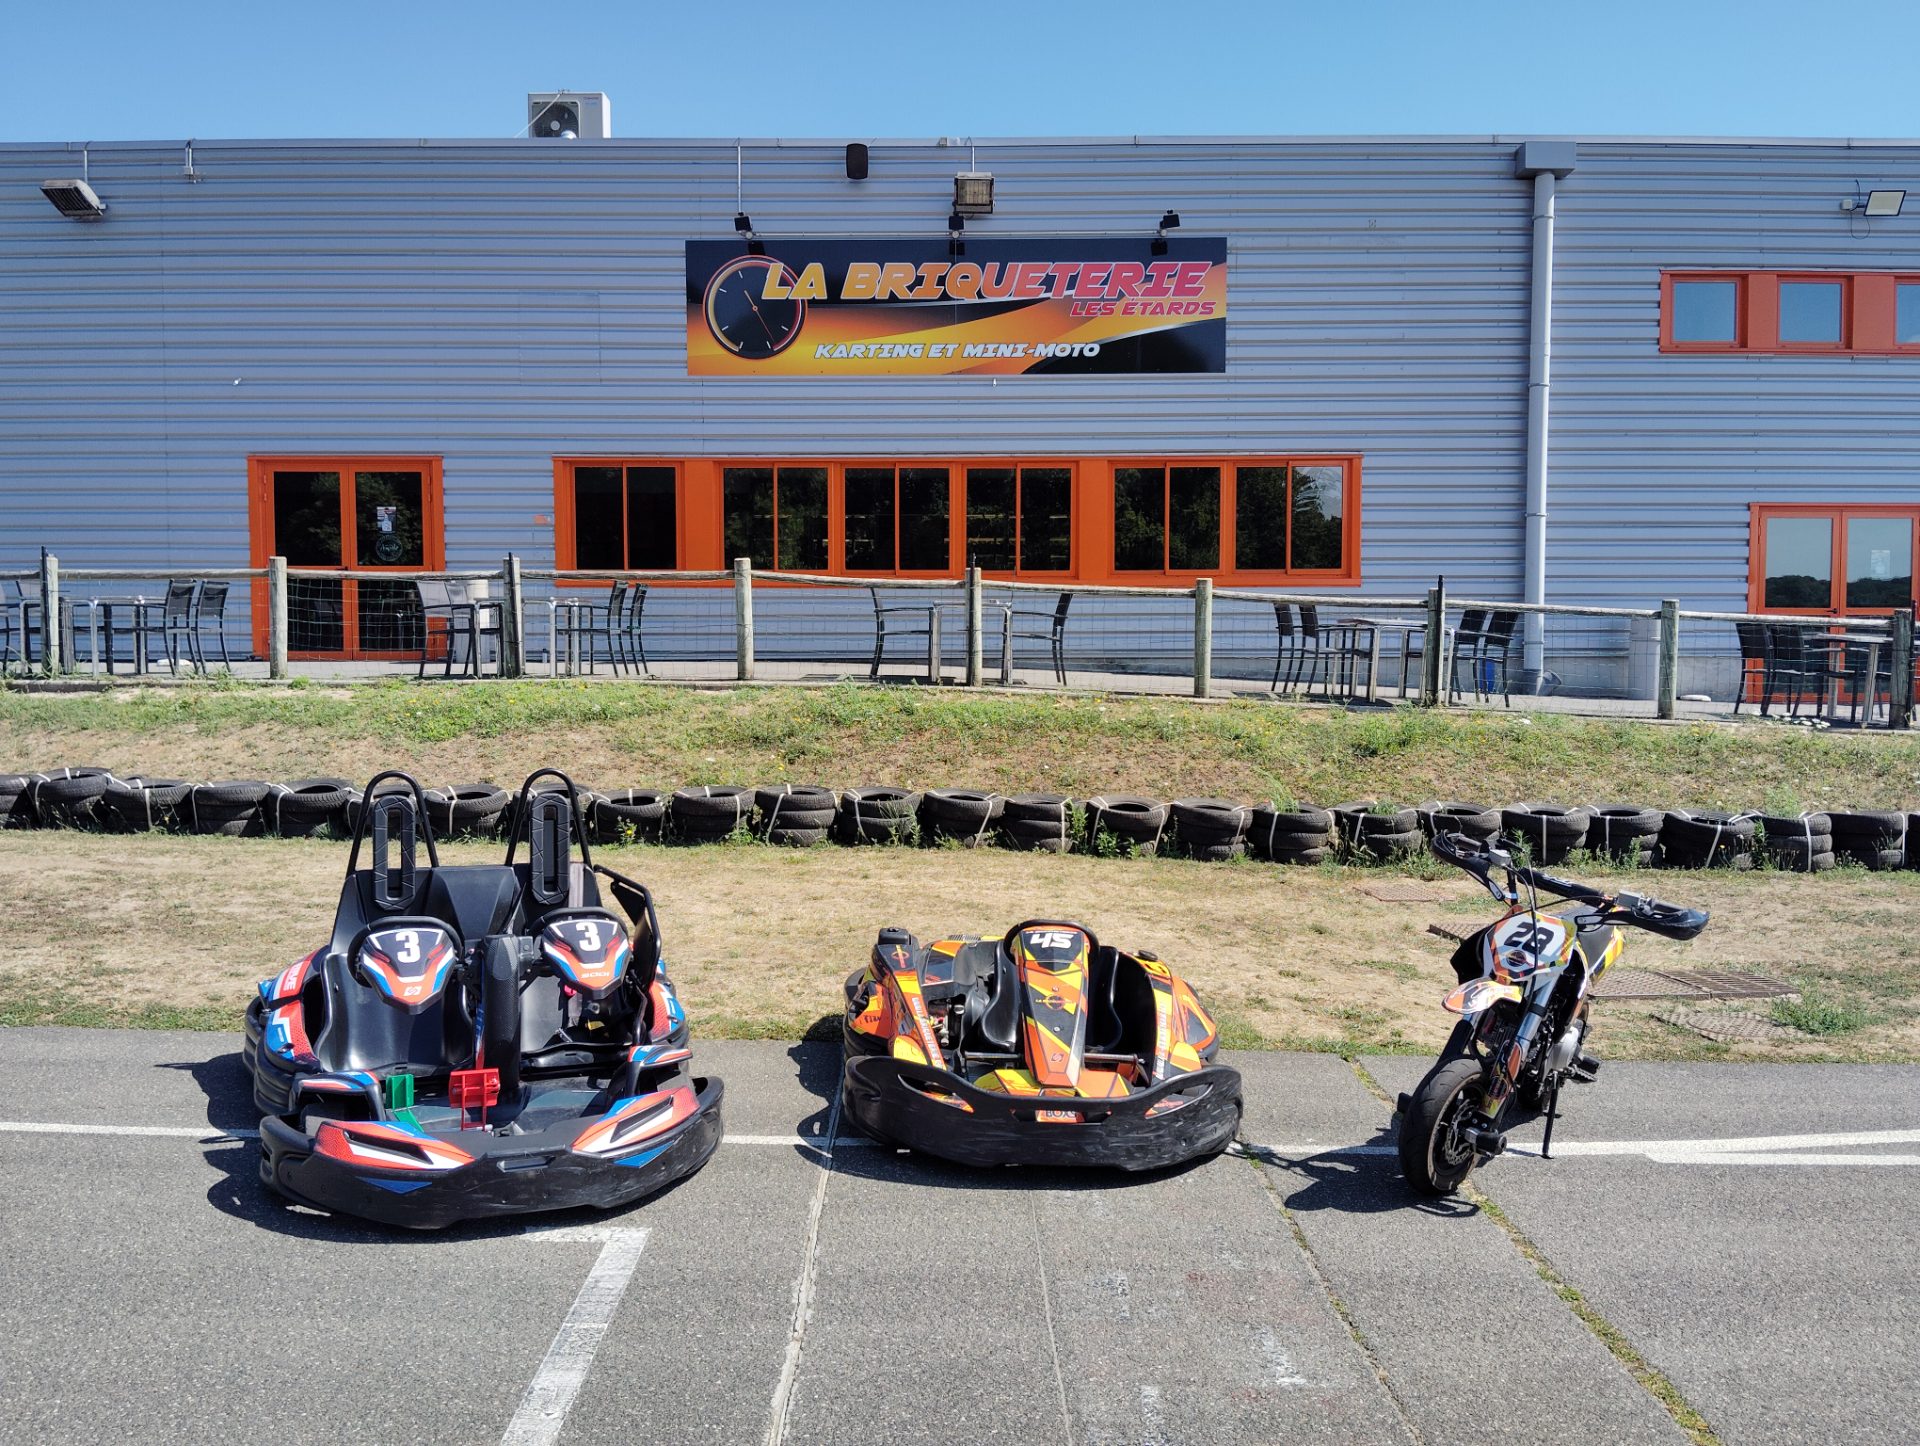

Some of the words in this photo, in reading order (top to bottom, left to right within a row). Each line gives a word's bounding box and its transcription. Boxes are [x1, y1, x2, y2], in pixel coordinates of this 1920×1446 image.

[761, 262, 828, 300] LA
[840, 261, 1213, 301] BRIQUETERIE
[1070, 301, 1117, 317] LES
[1120, 296, 1217, 317] ÉTARDS
[814, 343, 926, 360] KARTING
[927, 343, 961, 360] ET
[961, 343, 1100, 360] MINI-MOTO
[395, 931, 421, 964] 3
[576, 921, 601, 952] 3
[1030, 932, 1074, 949] 45
